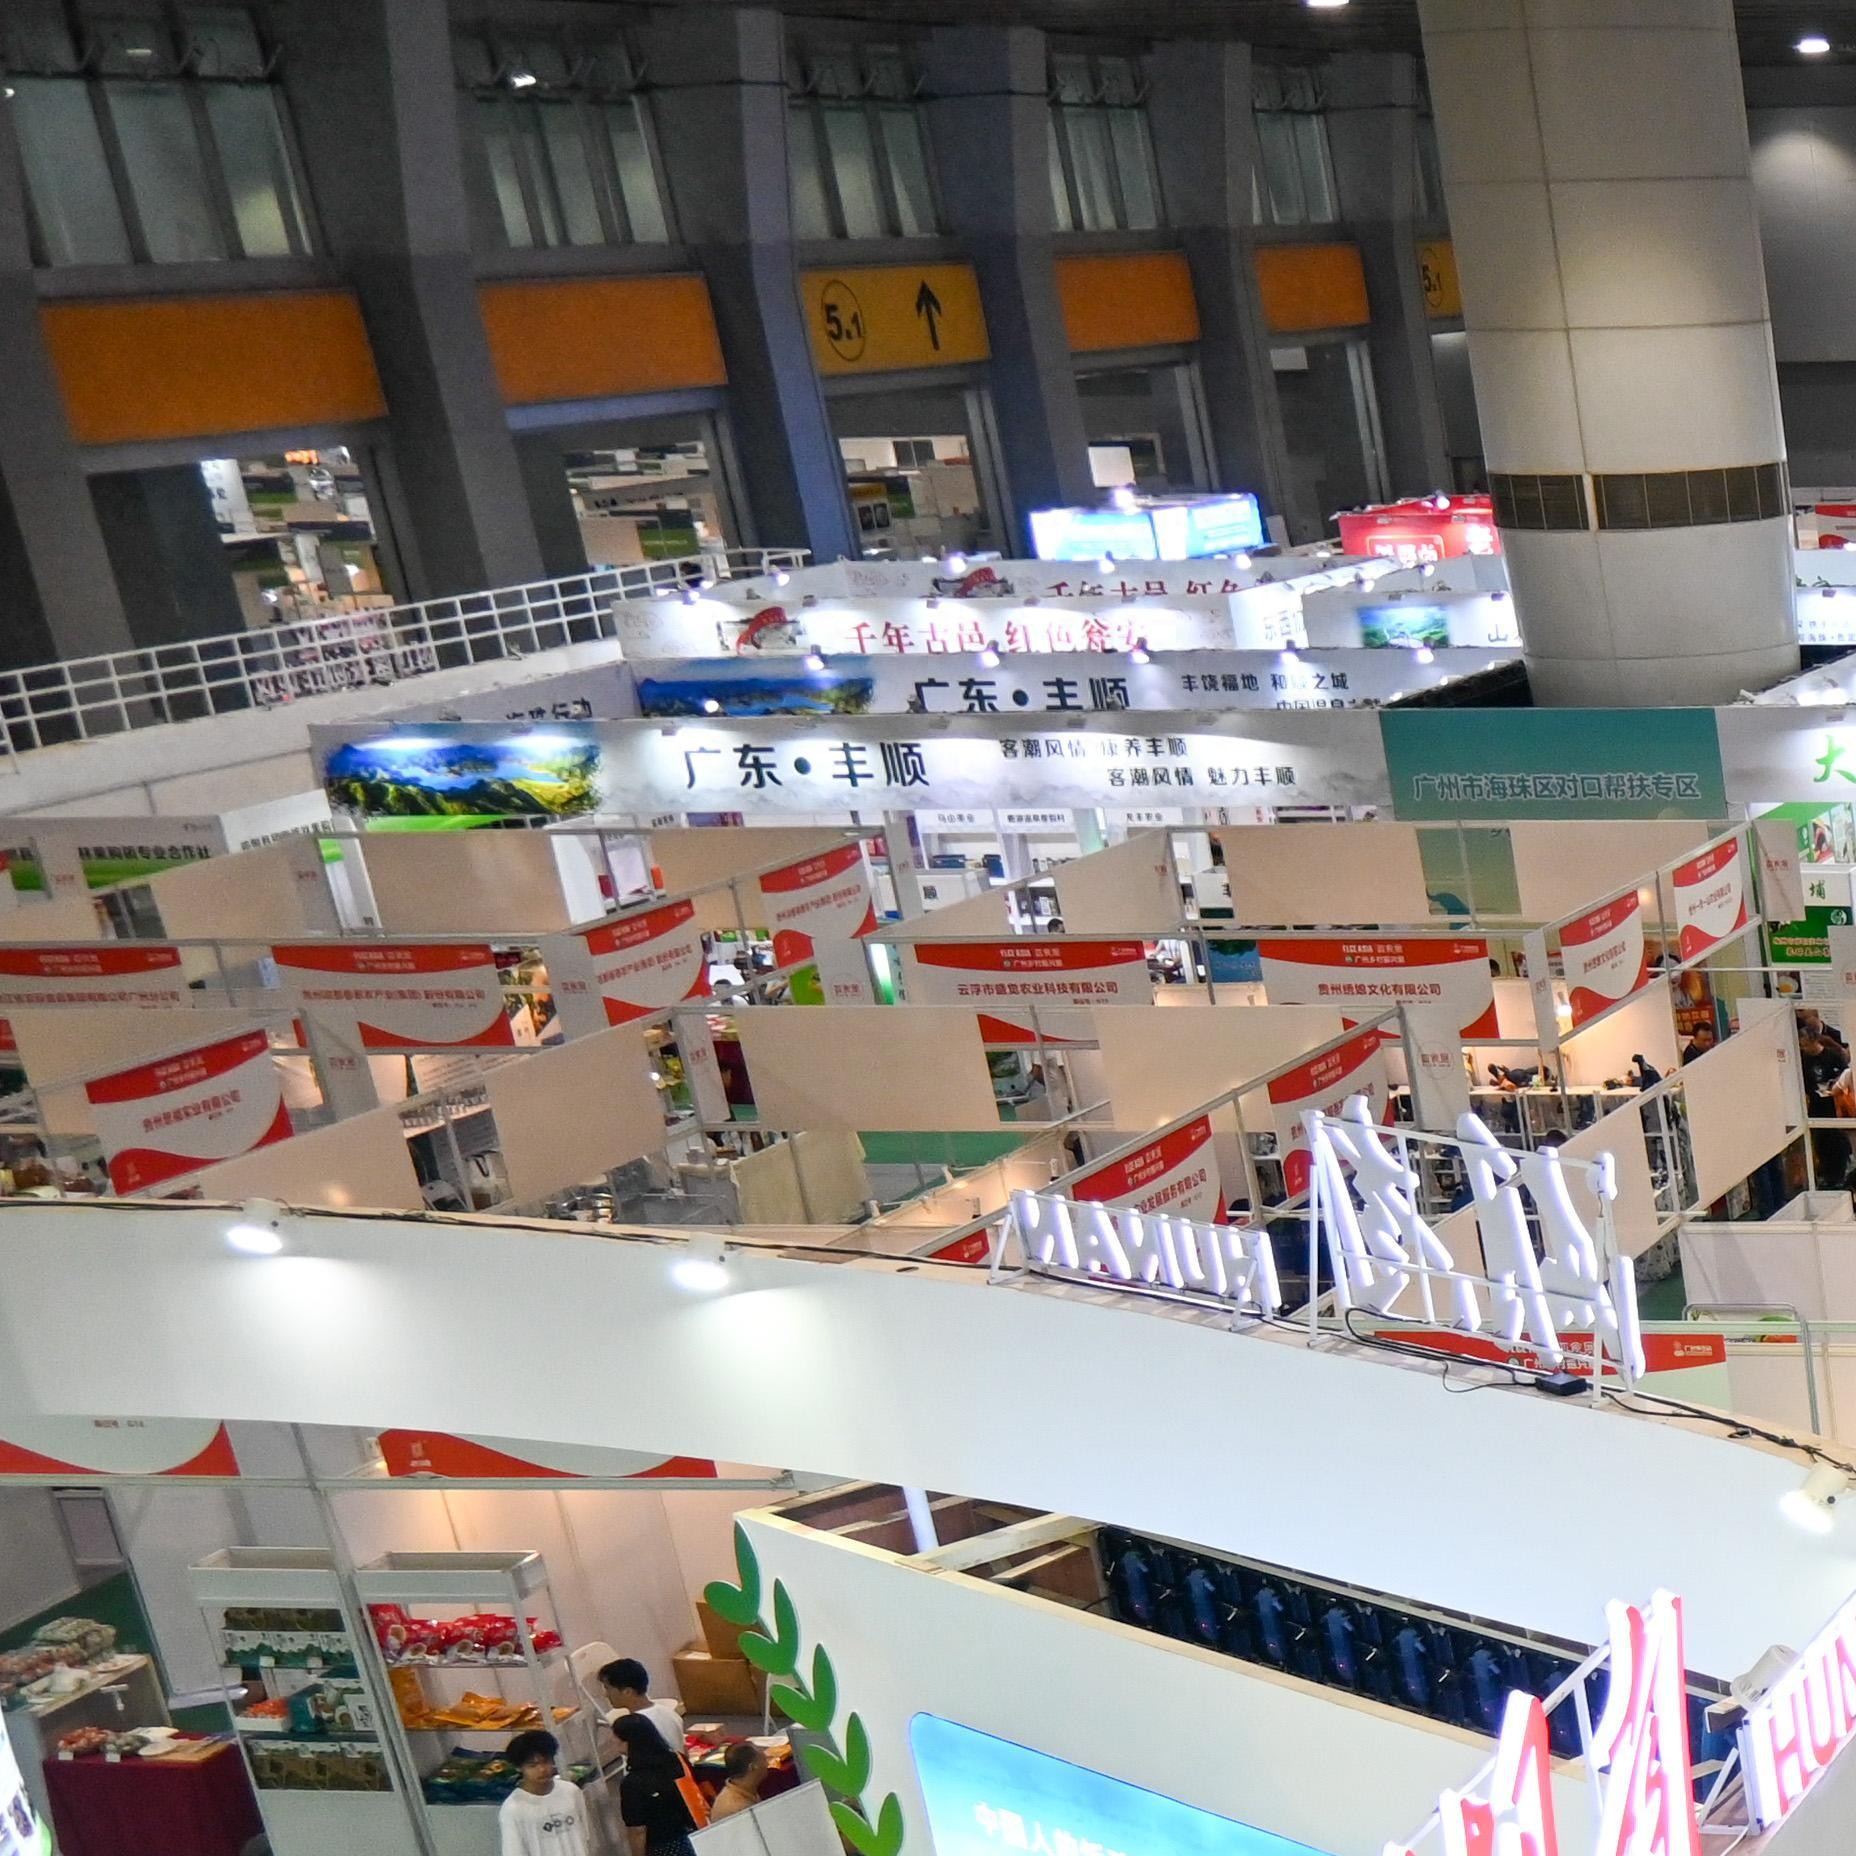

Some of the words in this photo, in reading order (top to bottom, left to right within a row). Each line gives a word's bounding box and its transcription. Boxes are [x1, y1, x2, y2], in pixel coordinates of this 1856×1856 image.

[823, 303, 862, 341] 5.1
[845, 620, 986, 654] 千年古邑
[1182, 673, 1260, 692] 丰饶福地
[1108, 766, 1195, 788] 客潮风情
[1207, 765, 1297, 787] 魅力丰顺
[1413, 773, 1700, 802] 广州市海珠区对口帮扶专区
